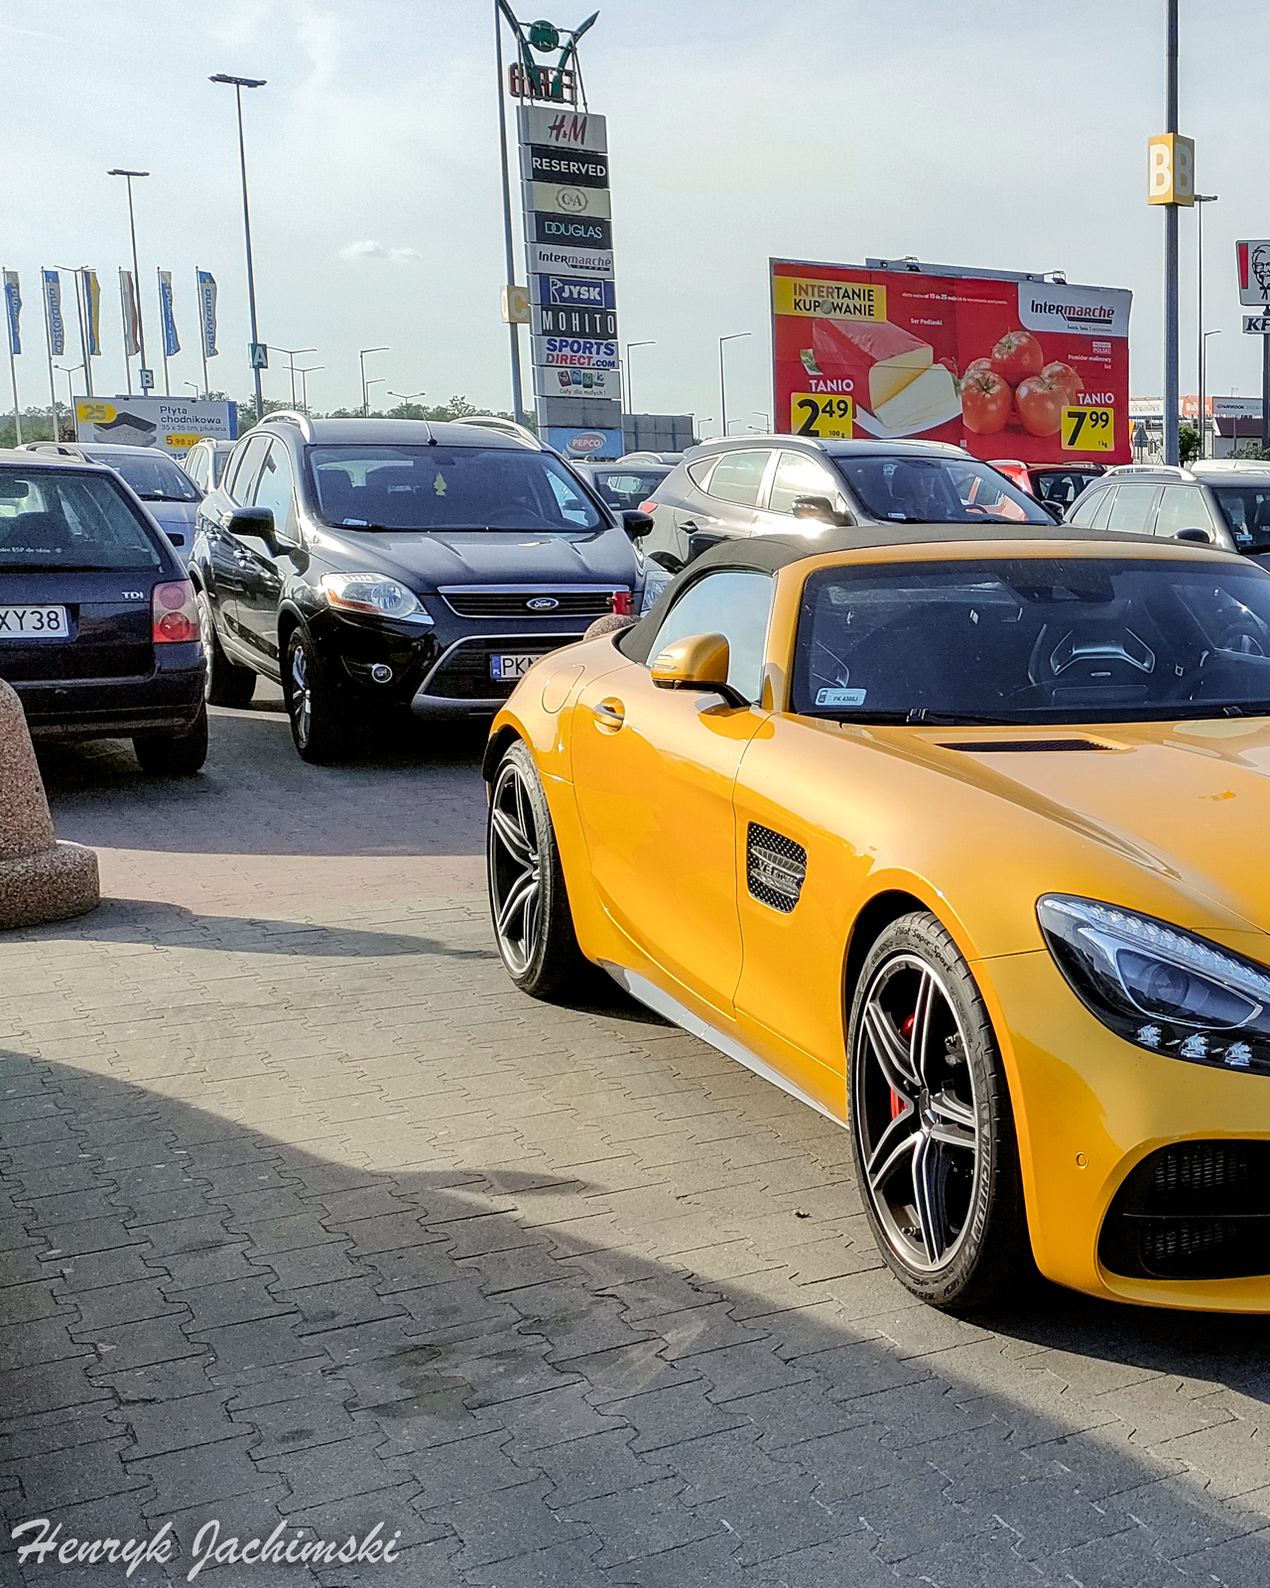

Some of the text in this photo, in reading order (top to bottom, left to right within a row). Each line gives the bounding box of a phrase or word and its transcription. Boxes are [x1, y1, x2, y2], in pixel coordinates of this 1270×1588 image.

[548, 114, 588, 145] H&M
[532, 157, 606, 177] RESERVED
[1150, 143, 1171, 197] B
[1174, 142, 1193, 196] B
[561, 192, 583, 207] C&A
[545, 221, 603, 239] DOUGLAS
[539, 250, 611, 267] Intermarché
[561, 285, 601, 300] JYSK
[793, 282, 874, 302] INTERTANIE
[509, 290, 528, 318] C
[1031, 299, 1115, 321] Intermarché
[542, 310, 615, 334] MOHITO
[920, 318, 943, 326] Podlaski
[254, 345, 267, 367] A
[546, 338, 615, 356] SPORTS
[142, 372, 153, 387] B
[809, 379, 854, 392] TANIO
[1077, 392, 1115, 405] TANIO
[83, 404, 106, 420] 25
[160, 405, 188, 416] Płyta
[161, 415, 221, 424] chodnikowa
[199, 425, 227, 433] płukana
[572, 438, 601, 448] PEPCO
[121, 591, 144, 599] TDI
[0, 610, 60, 631] XY38
[911, 929, 931, 947] Super
[931, 944, 954, 974] Sport
[970, 1135, 991, 1244] MICHELIN
